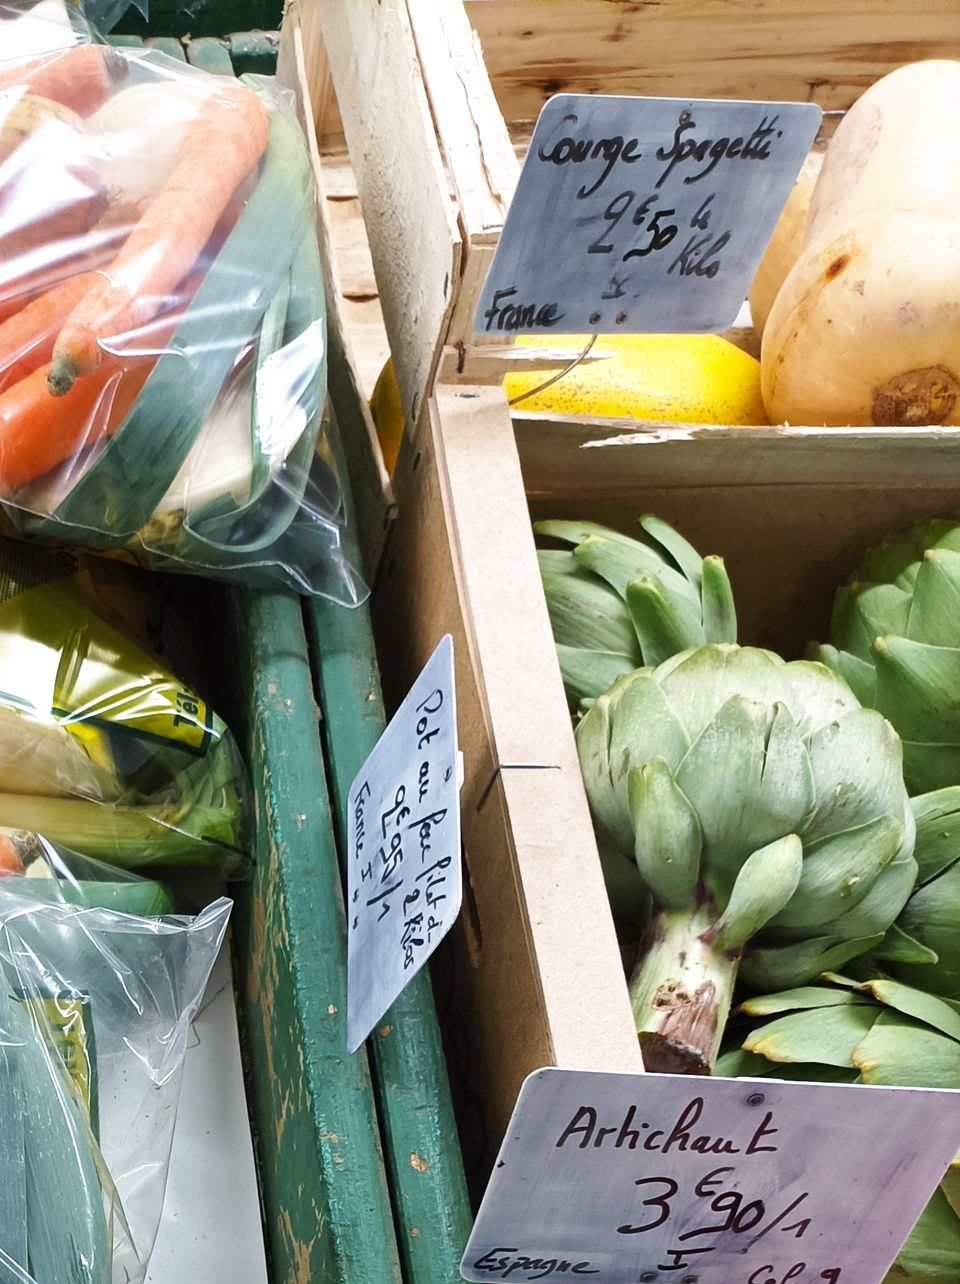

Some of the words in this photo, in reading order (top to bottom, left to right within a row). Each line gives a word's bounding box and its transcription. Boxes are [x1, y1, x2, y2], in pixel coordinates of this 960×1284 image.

[539, 114, 642, 200] Courge
[416, 689, 444, 751] Pot
[556, 1096, 779, 1155] Artichaut
[473, 1246, 601, 1280] Espagne
